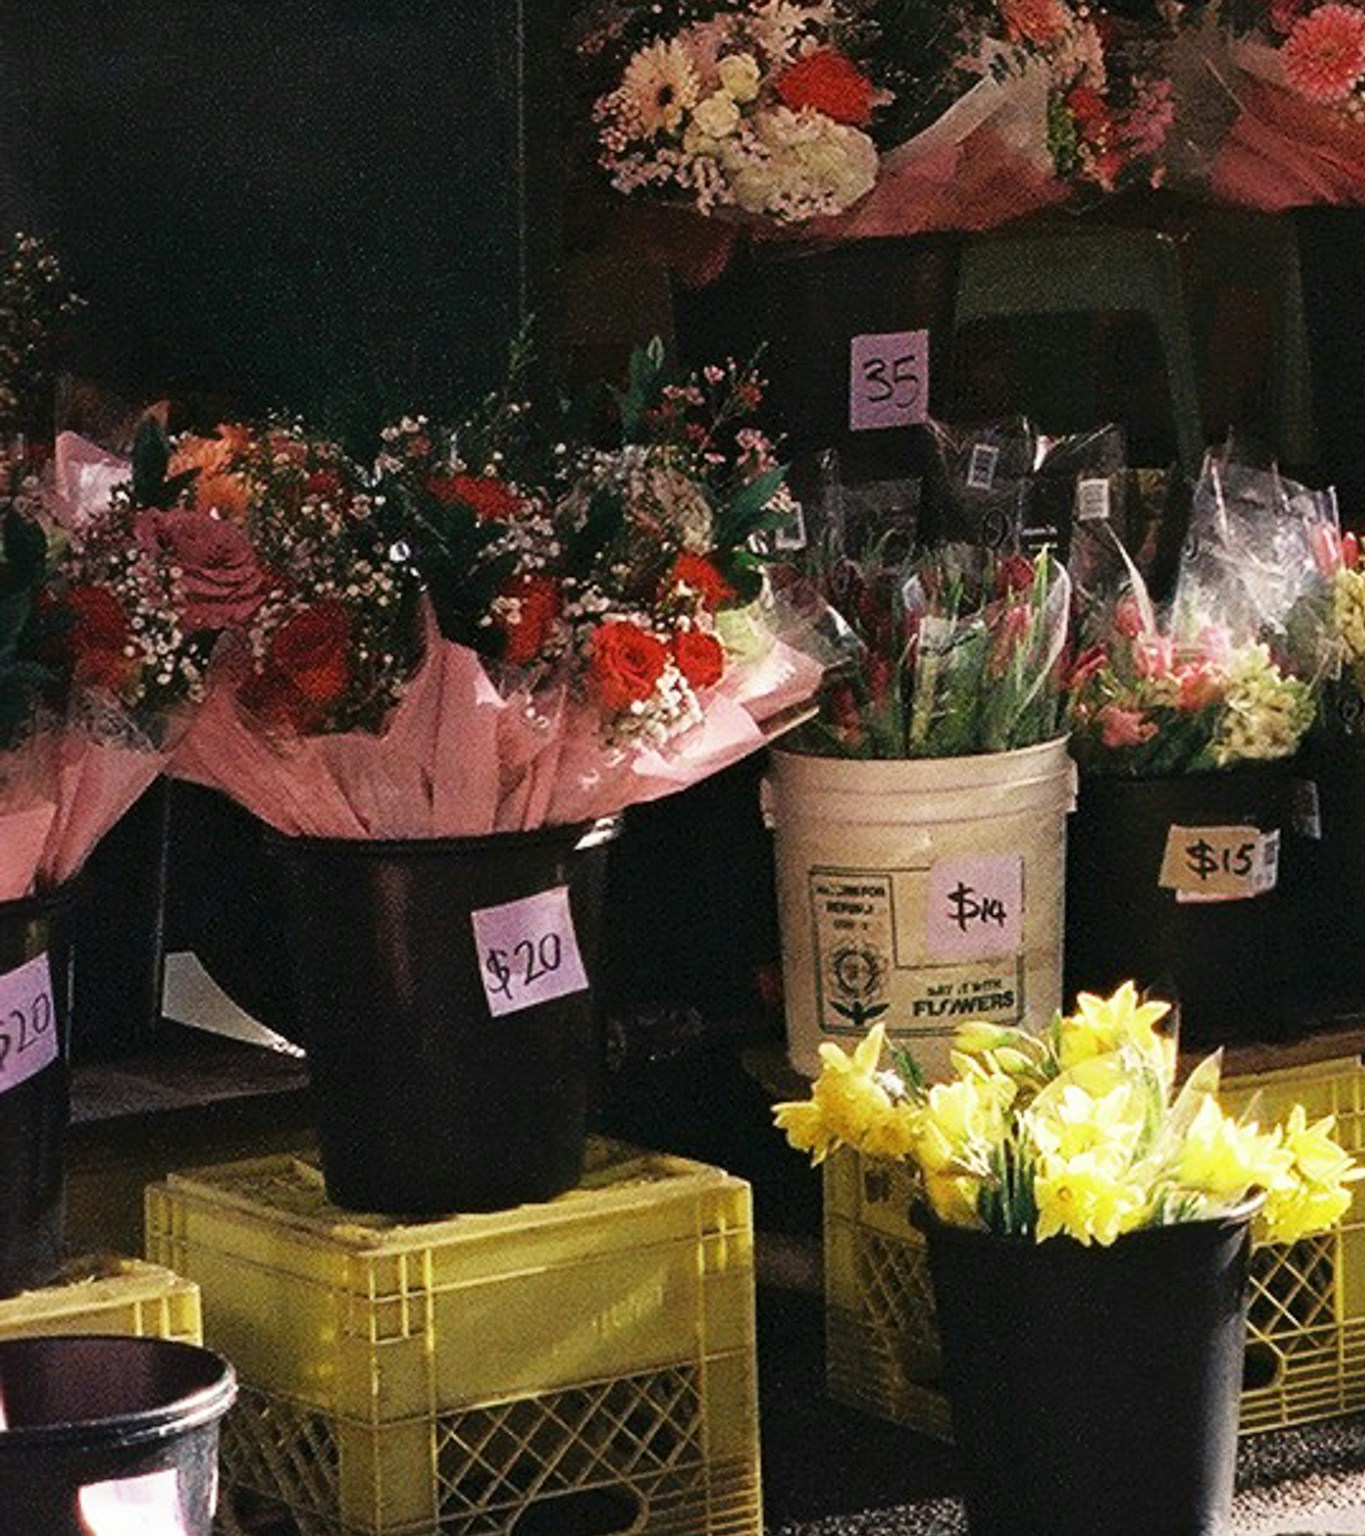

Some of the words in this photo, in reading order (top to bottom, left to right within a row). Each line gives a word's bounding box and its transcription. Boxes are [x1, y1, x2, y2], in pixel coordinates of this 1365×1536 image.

[862, 354, 920, 409] 35
[1185, 838, 1257, 881] $15
[486, 932, 562, 1001] $20
[912, 990, 1015, 1017] FLOWERS
